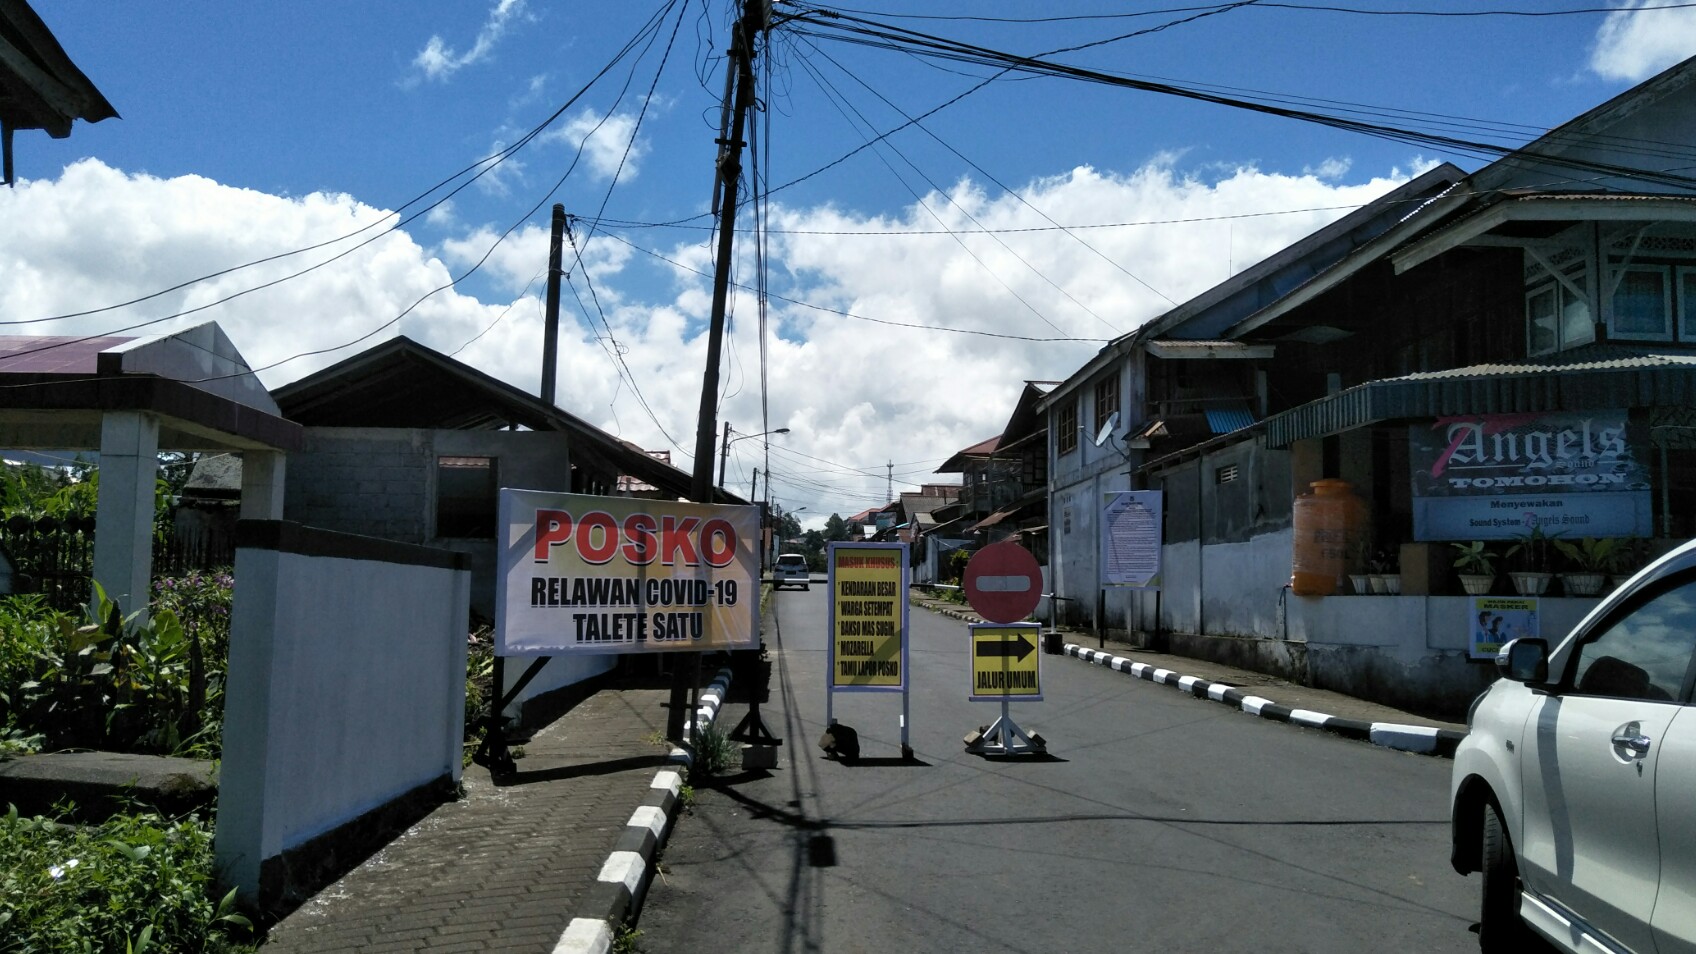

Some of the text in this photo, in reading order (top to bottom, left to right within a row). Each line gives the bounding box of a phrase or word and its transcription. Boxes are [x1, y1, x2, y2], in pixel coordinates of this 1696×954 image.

[1447, 418, 1625, 469] Angels
[1448, 472, 1627, 489] TOMOHON
[1489, 499, 1563, 509] Menyewakan
[1469, 518, 1492, 527] Sound
[1493, 518, 1521, 527] System
[534, 508, 737, 568] POSKO
[838, 556, 865, 568] MASUK
[531, 577, 738, 608] RELAWAN COVID-19
[841, 580, 897, 597] KENDARAAN BESAR
[841, 600, 894, 617] WARGA SETEMPAT
[573, 611, 703, 644] TALETE SATU
[840, 620, 861, 636] BAKSO
[861, 620, 875, 636] MAS
[840, 640, 875, 657] MOZARELLA
[840, 660, 898, 677] TAMU LAPOR POSKO
[977, 670, 1036, 689] JALUR UMUM
